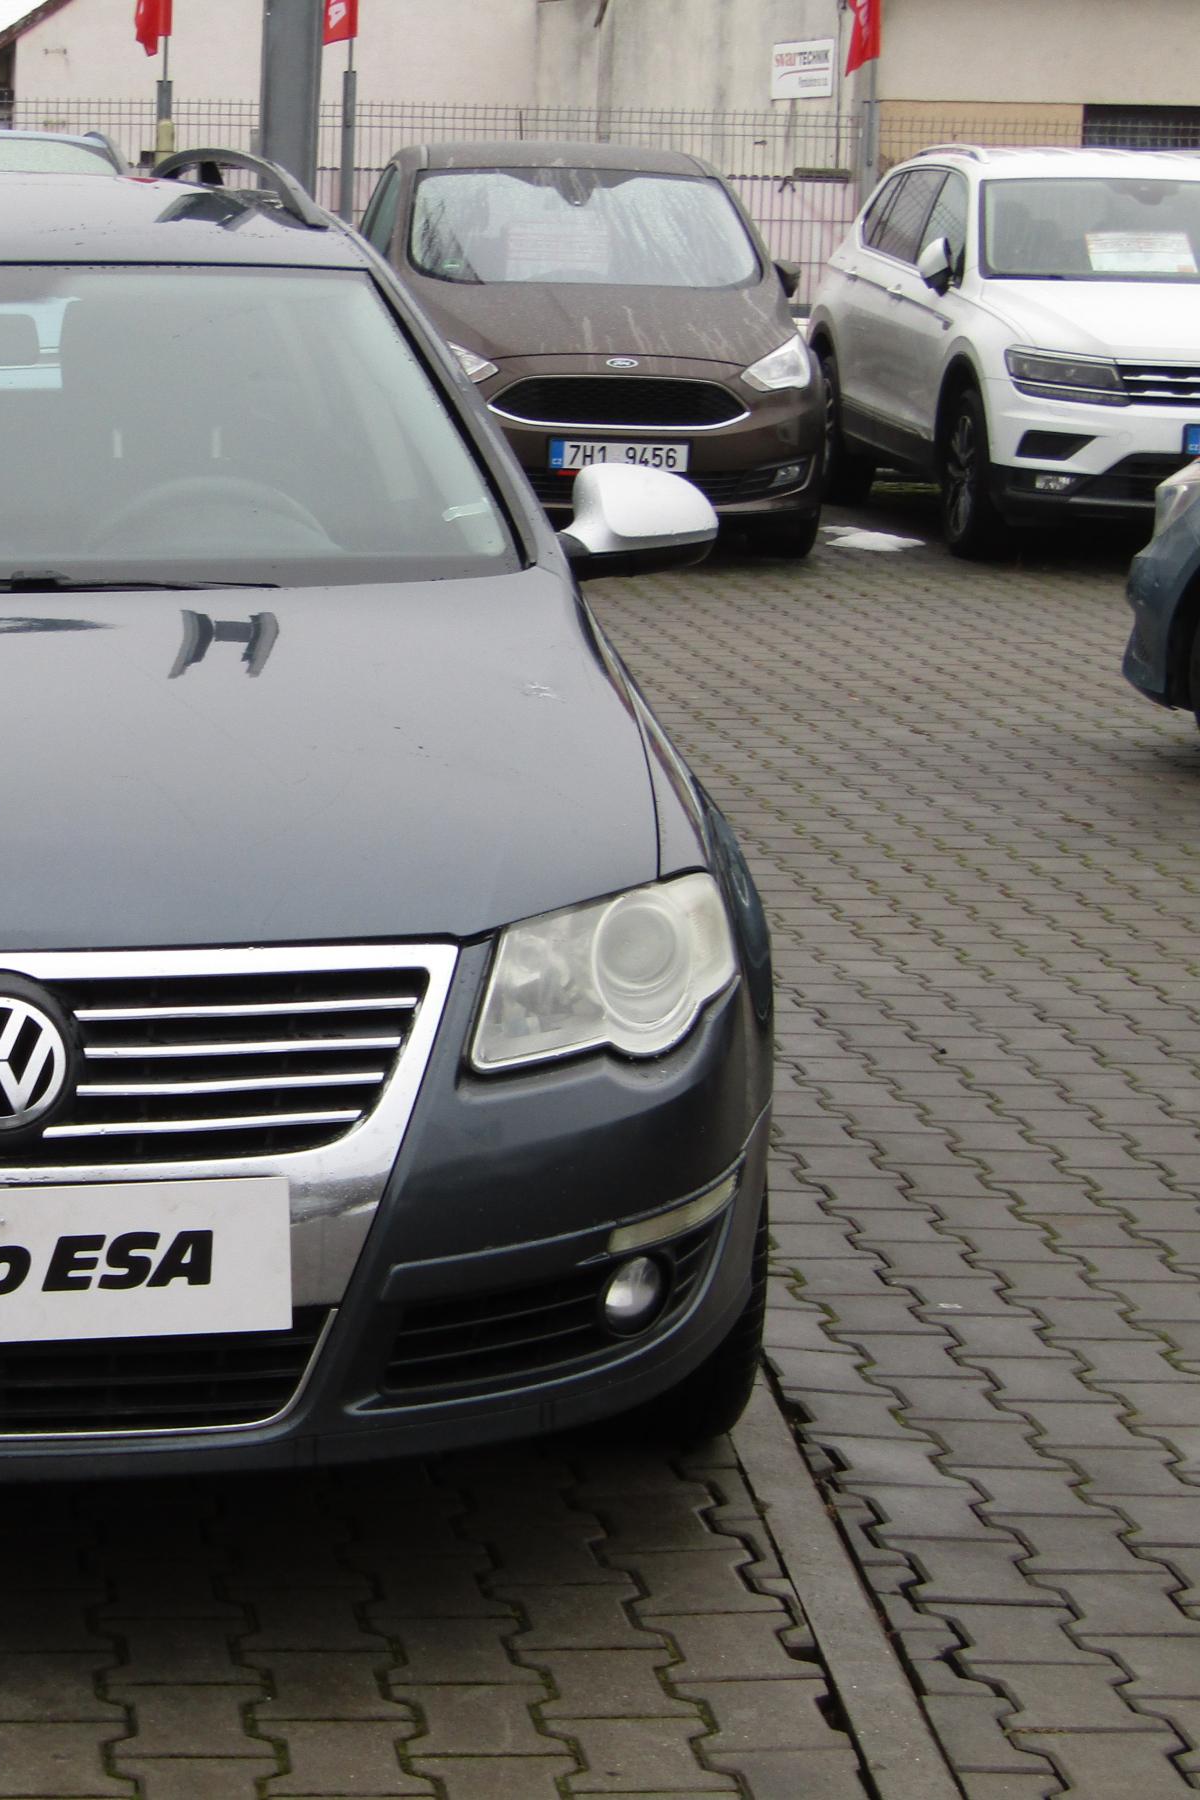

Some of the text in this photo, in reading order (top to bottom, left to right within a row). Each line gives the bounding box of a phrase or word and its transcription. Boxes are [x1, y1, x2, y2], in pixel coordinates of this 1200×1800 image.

[569, 445, 607, 465] 7H1
[625, 447, 677, 469] 9456
[41, 1229, 213, 1292] ESA
